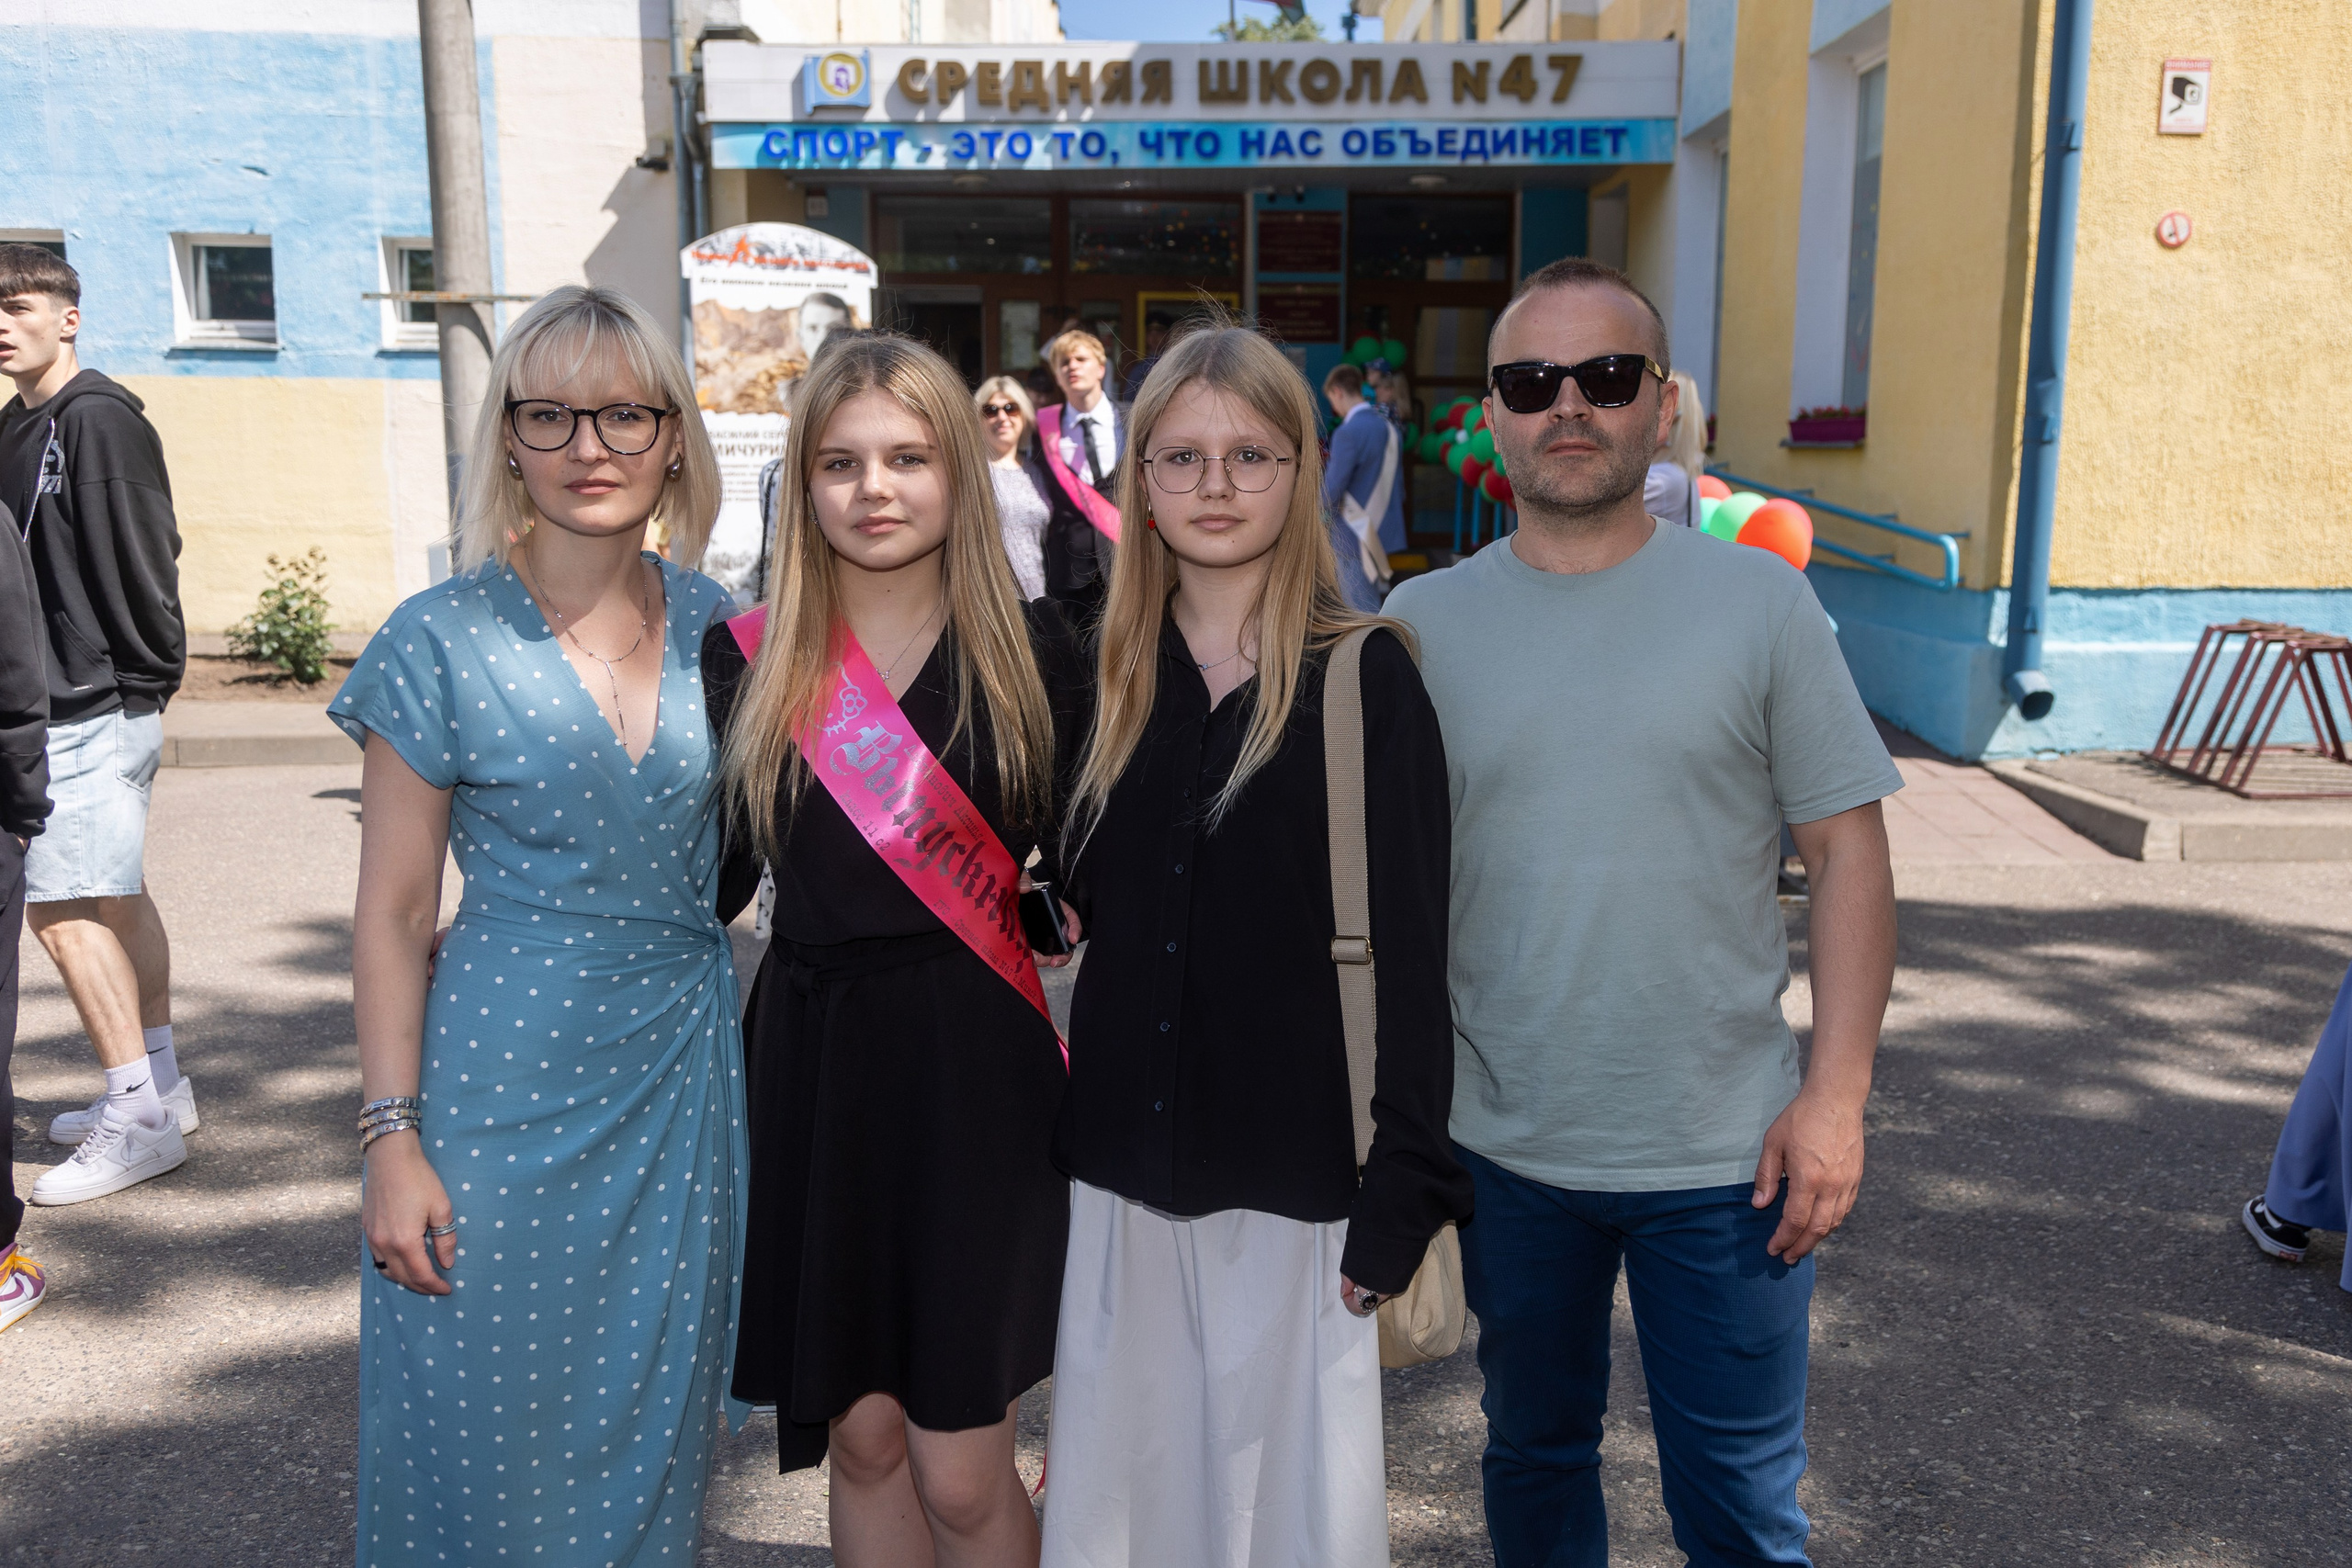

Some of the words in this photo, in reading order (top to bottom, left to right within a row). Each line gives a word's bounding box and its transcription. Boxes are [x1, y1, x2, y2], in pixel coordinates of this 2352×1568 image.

[899, 59, 1173, 112] СРЕДНЯЯ
[1198, 58, 1429, 104] ШКОЛА
[1452, 54, 1584, 104] N47
[763, 130, 904, 160] СПОРТ
[952, 130, 1033, 161] ЭТО
[1053, 130, 1119, 165] ТО,
[1139, 130, 1220, 160] ЧТО
[1239, 130, 1323, 159] НАС
[1341, 127, 1628, 163] ОБЪЕДИНЯЕТ
[830, 720, 1035, 974] Выпускниц
[862, 819, 879, 838] 11
[979, 942, 1002, 964] школа
